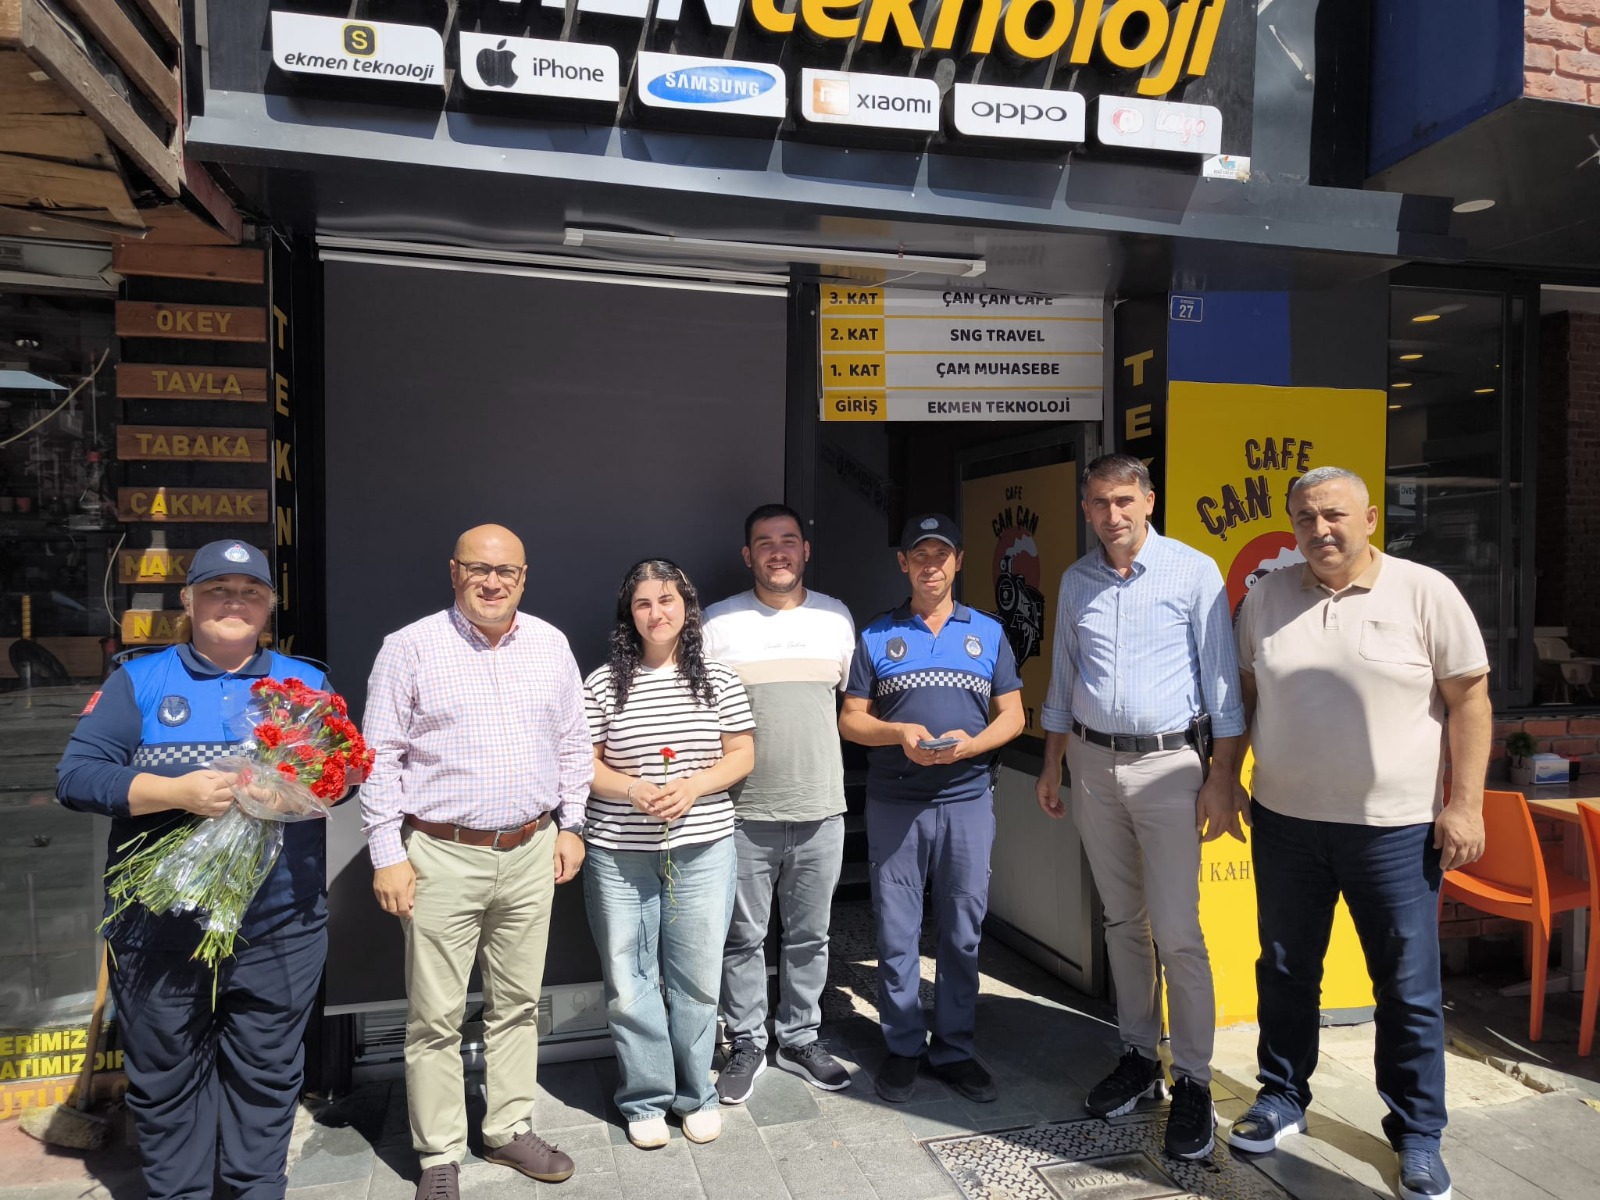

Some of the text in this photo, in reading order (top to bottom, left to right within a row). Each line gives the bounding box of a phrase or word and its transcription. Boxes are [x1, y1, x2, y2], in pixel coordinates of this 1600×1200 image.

[284, 52, 434, 81] ekmen teknoloji
[533, 57, 604, 82] iPhone
[665, 72, 760, 96] SAMSUNG
[829, 291, 878, 305] 3. KAT
[942, 291, 1053, 308] ÇAN ÇAN CAFE
[1179, 304, 1194, 318] 27
[156, 310, 232, 333] OKEY
[830, 328, 878, 341] 2. KAT
[950, 329, 1045, 342] SNG TRAVEL
[830, 364, 880, 377] 1. KAT
[936, 362, 1060, 378] ÇAM MUHASEBE
[152, 370, 242, 395] TAVLA
[835, 396, 878, 415] GİRİŞ
[927, 397, 1071, 414] EKMEN TEKNOLOJİ
[135, 432, 252, 457] TABAKA
[1244, 437, 1313, 473] CAFE
[1005, 485, 1023, 501] CAFE
[1196, 475, 1272, 541] ÇAN
[124, 555, 187, 577] MAK
[1210, 860, 1251, 882] KAH
